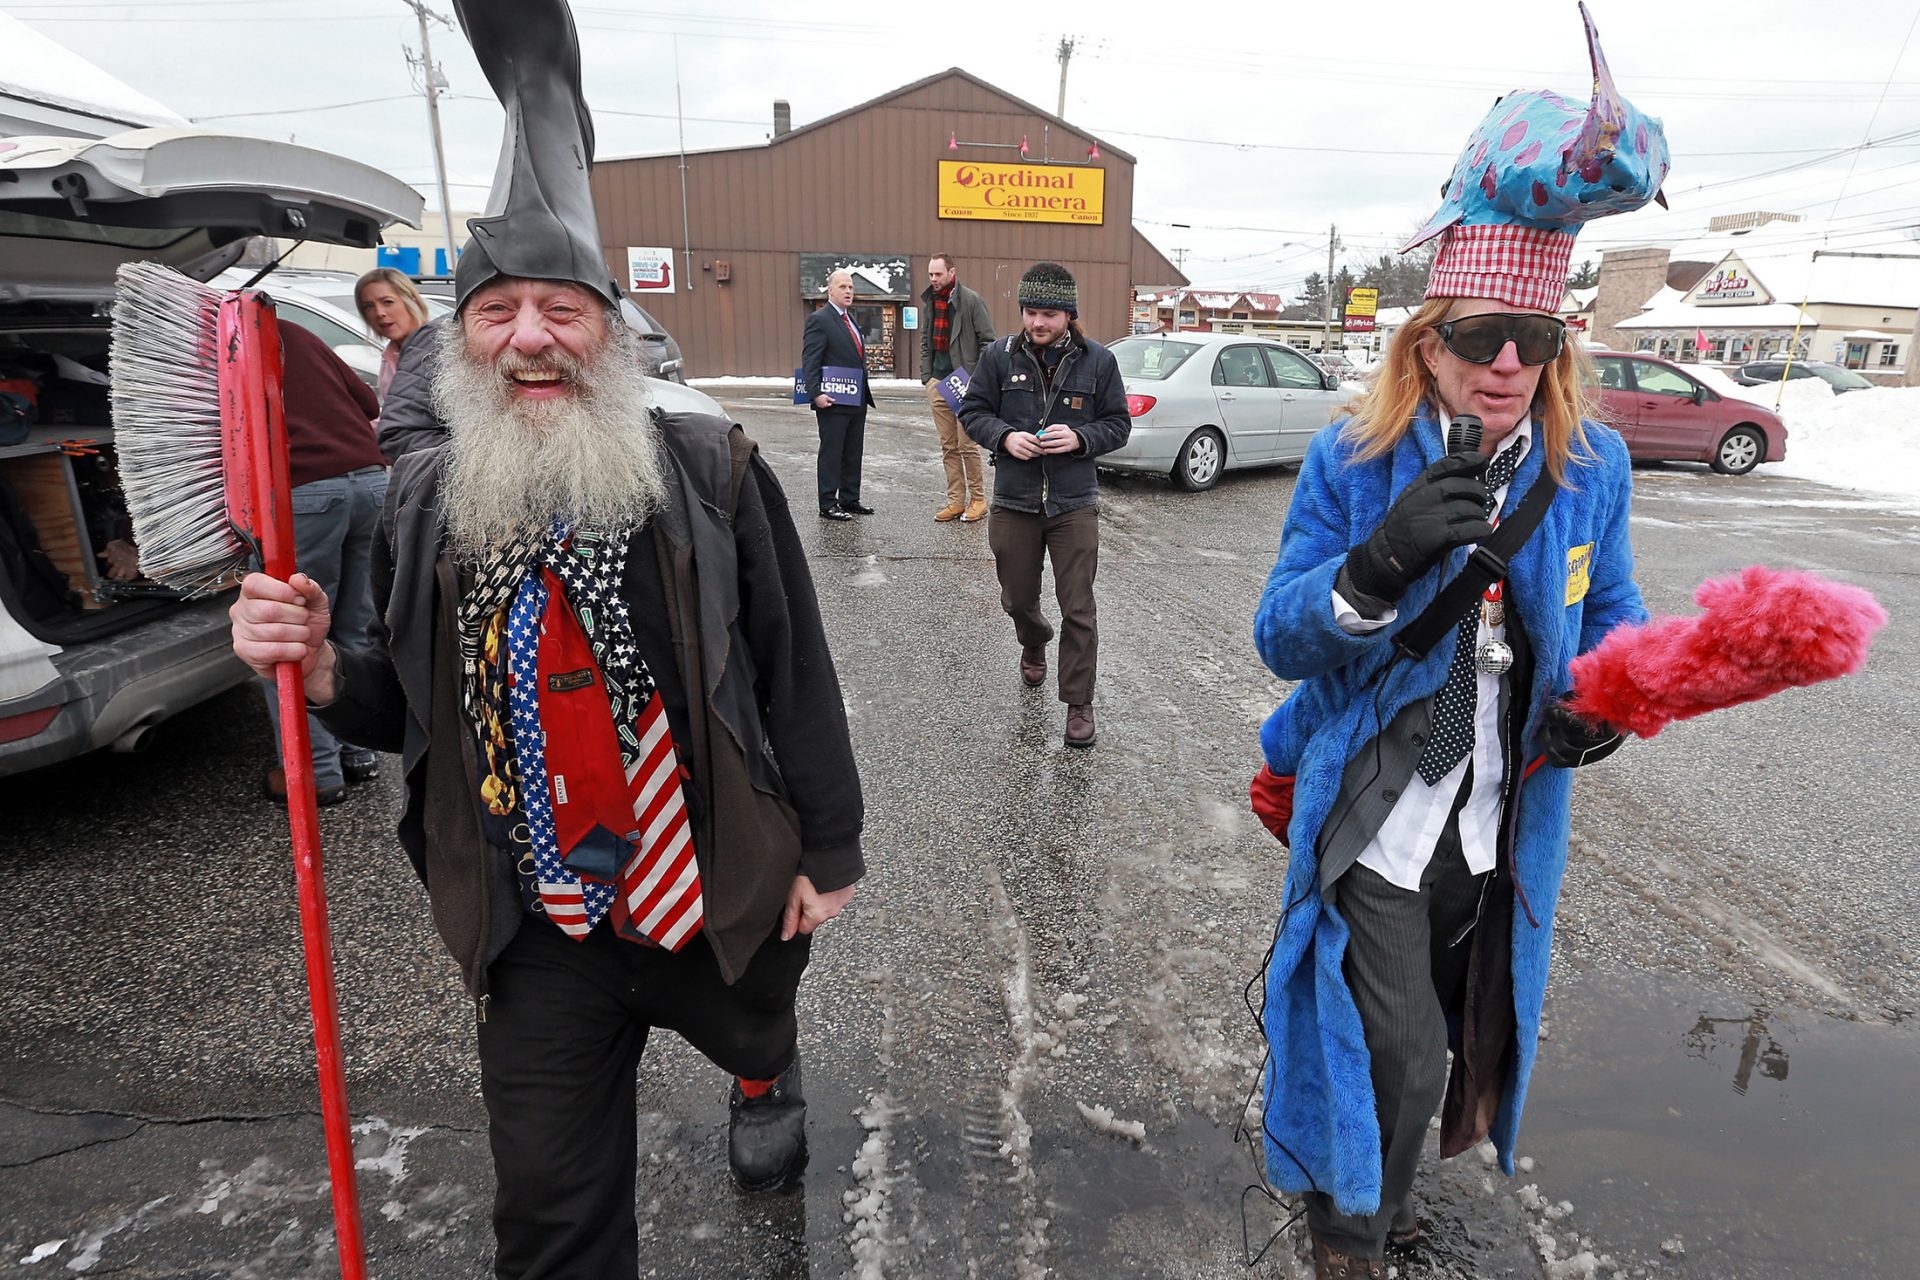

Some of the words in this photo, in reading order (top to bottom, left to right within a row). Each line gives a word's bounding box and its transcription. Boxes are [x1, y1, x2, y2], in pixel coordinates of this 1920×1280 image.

[954, 165, 1074, 189] Cardinal
[984, 187, 1086, 210] Camera
[944, 208, 972, 216] Canon
[1002, 210, 1022, 218] Since
[1071, 213, 1098, 221] Canon
[1705, 279, 1721, 293] Jay
[820, 382, 858, 395] CHRIST
